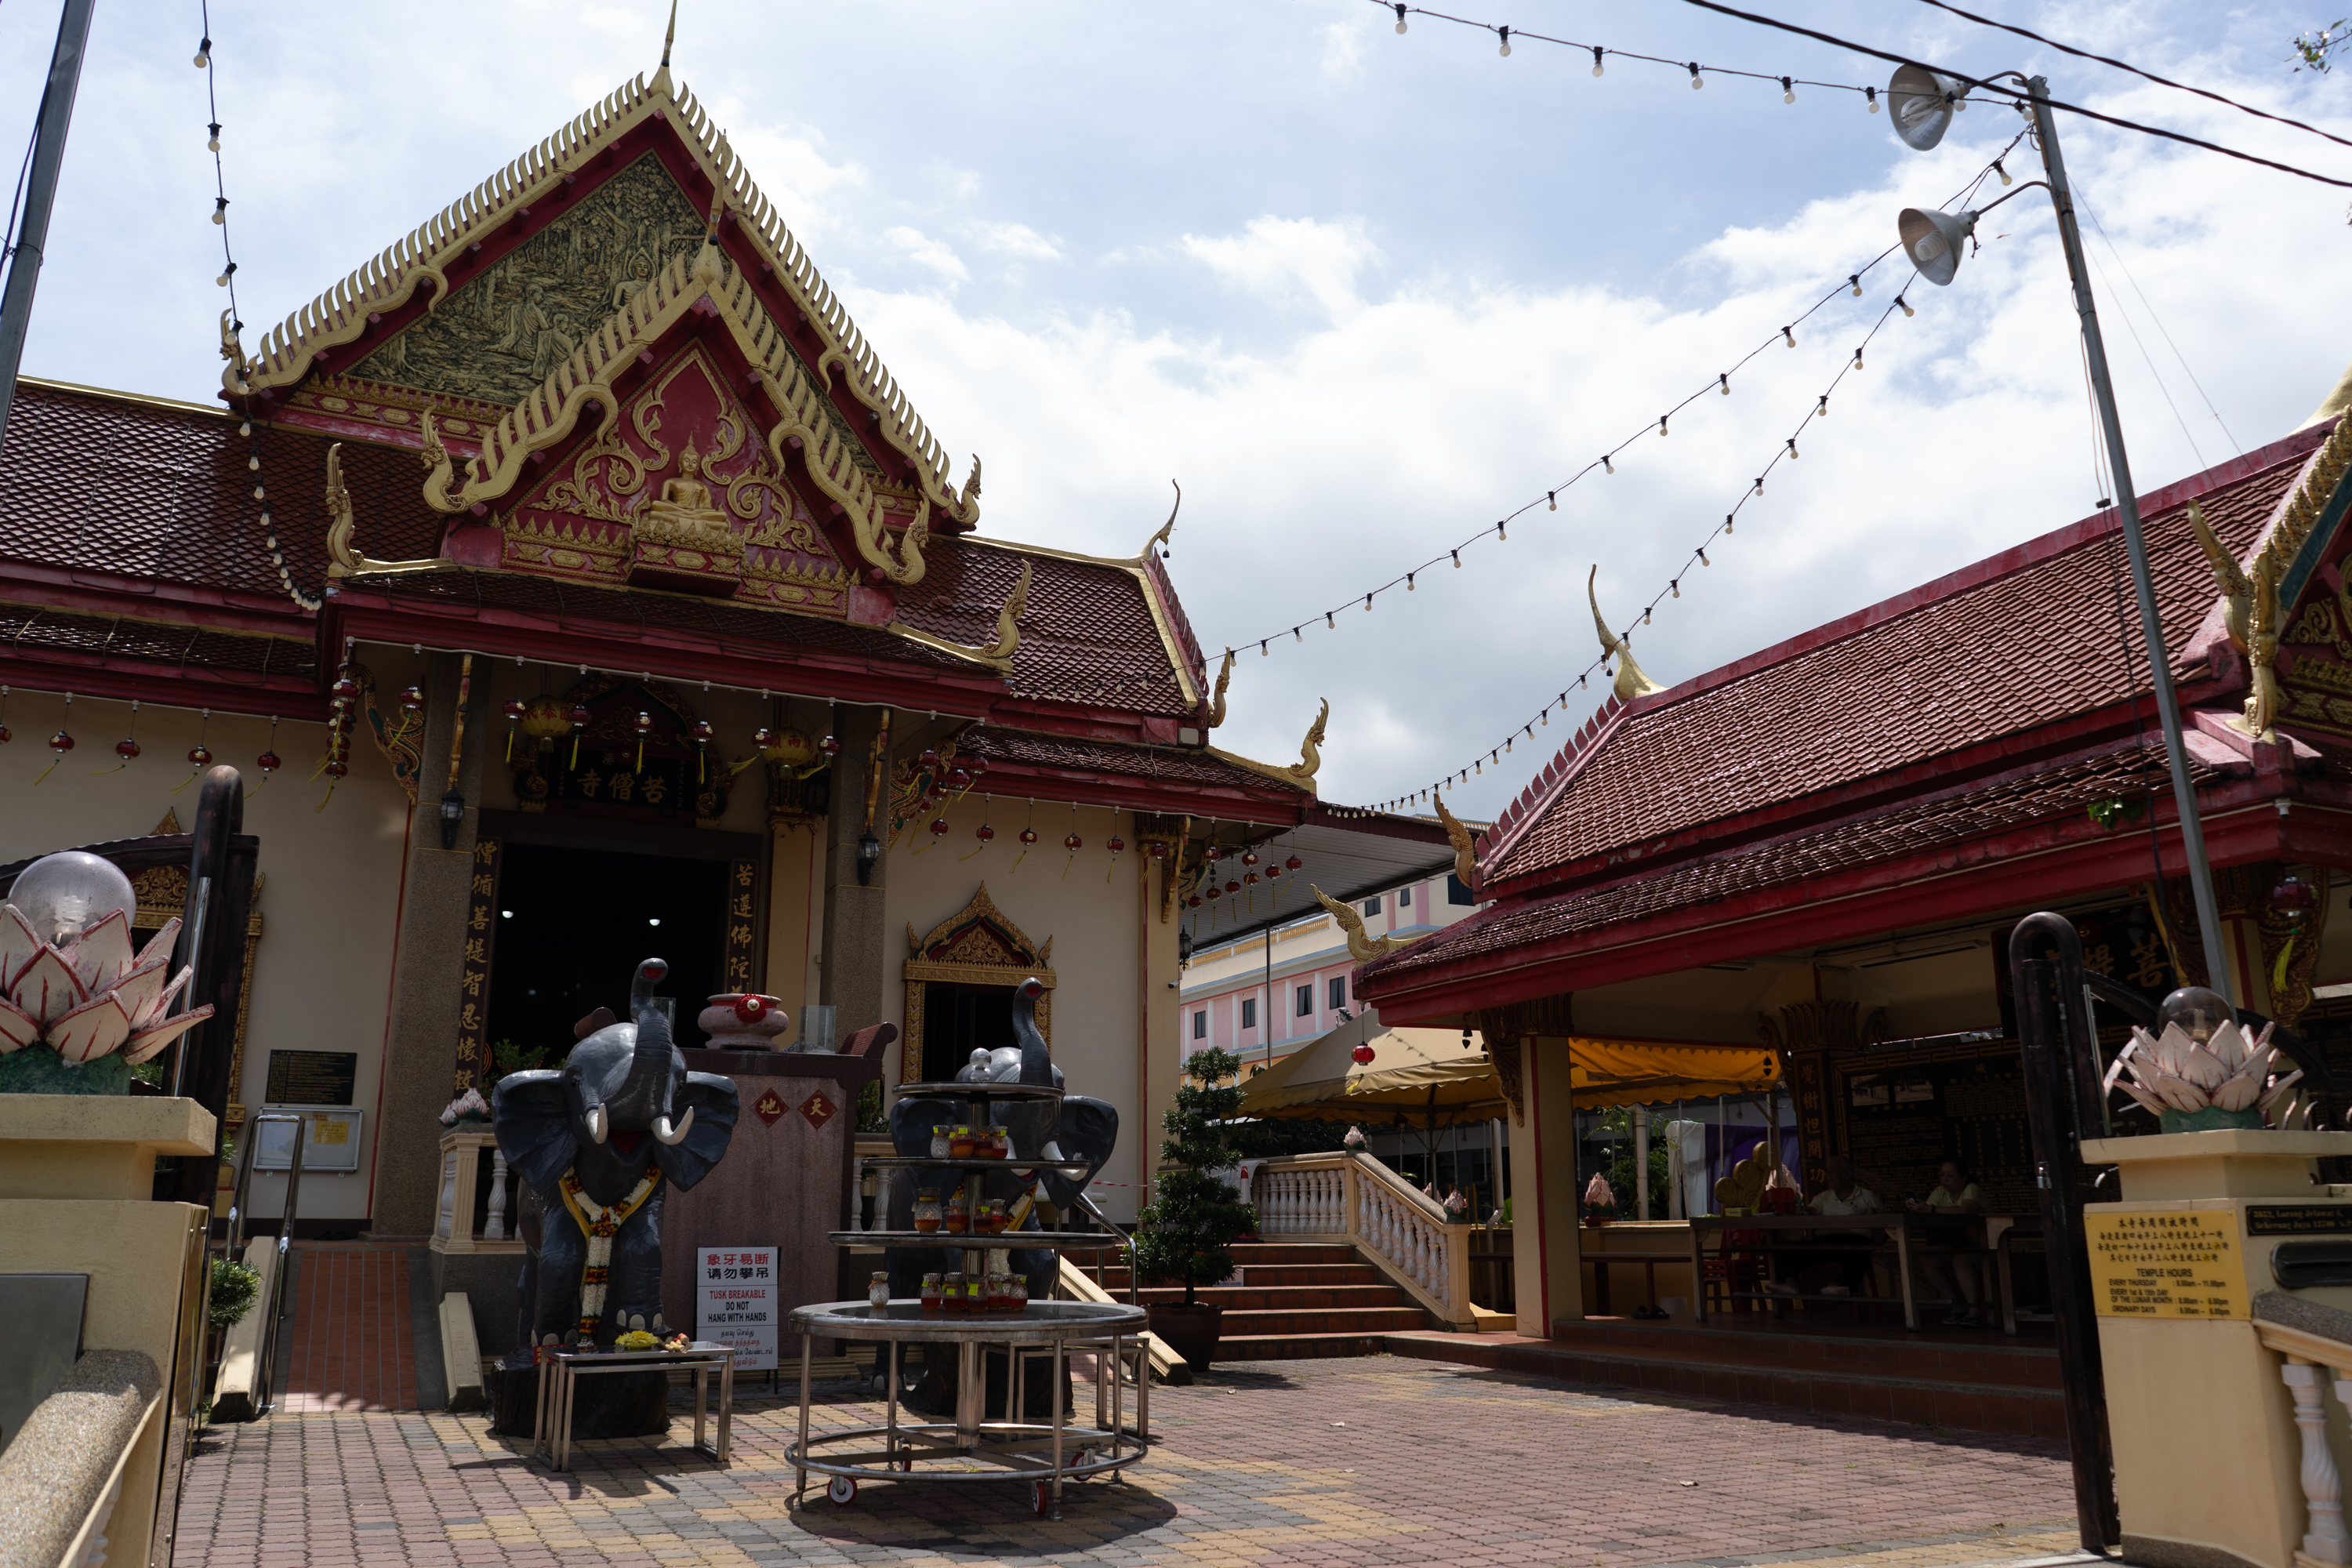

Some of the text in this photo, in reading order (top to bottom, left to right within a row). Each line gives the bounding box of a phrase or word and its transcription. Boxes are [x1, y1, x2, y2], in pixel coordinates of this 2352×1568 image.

[759, 1098, 780, 1114] 地
[809, 1097, 827, 1116] 天
[707, 1254, 769, 1265] 象牙易断
[707, 1267, 769, 1279] 请勿攀吊
[2136, 1269, 2193, 1277] TEMPLE HOURS
[710, 1290, 766, 1300] TUSK BREAKABLE
[726, 1301, 750, 1311] DO NOT
[708, 1312, 767, 1323] HANG WITH HANDS
